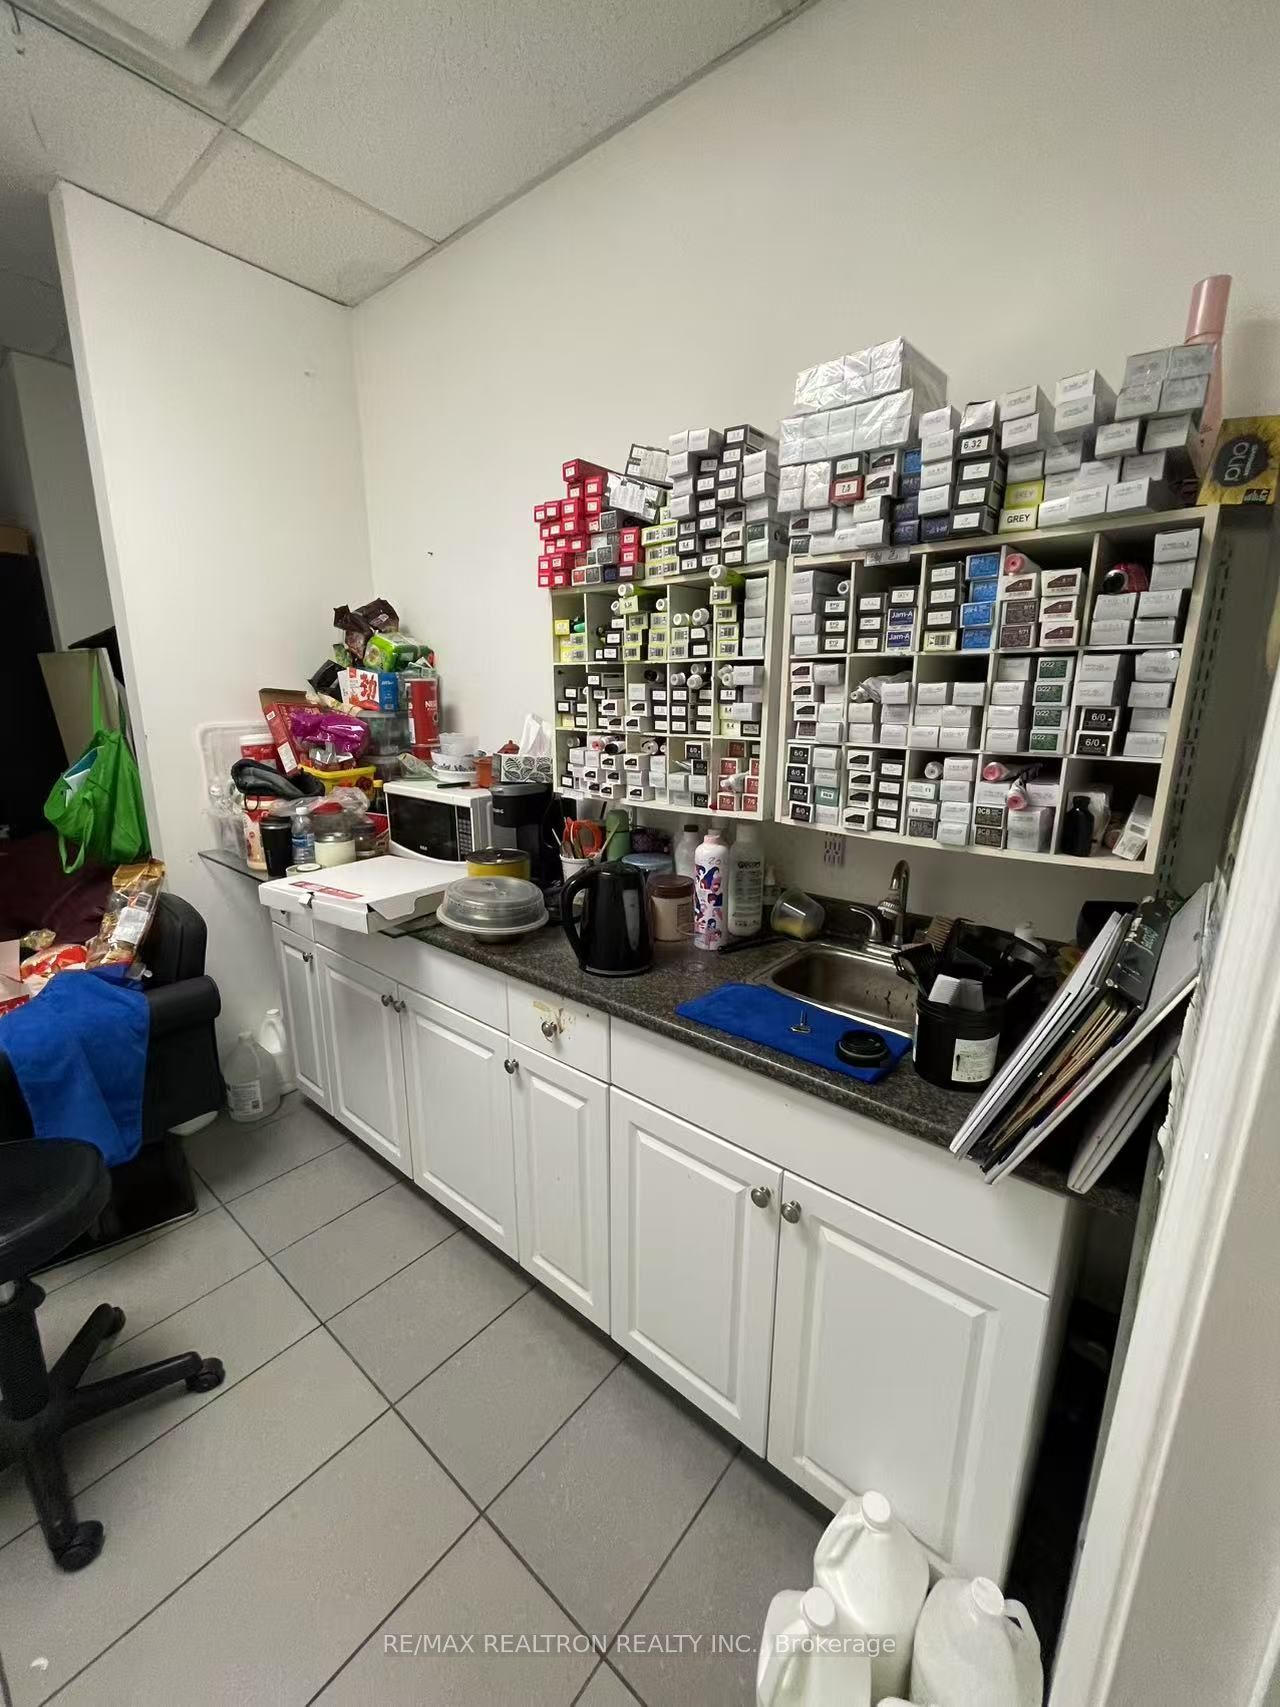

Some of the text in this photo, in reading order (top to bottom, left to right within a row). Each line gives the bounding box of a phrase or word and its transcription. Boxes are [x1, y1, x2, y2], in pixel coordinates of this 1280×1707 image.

[963, 439, 982, 449] 6.32
[1007, 513, 1031, 524] GREY
[891, 610, 913, 619] Jam-A
[888, 633, 910, 641] Jam-A
[1091, 713, 1106, 721] 6/0
[1085, 738, 1100, 746] 6/0
